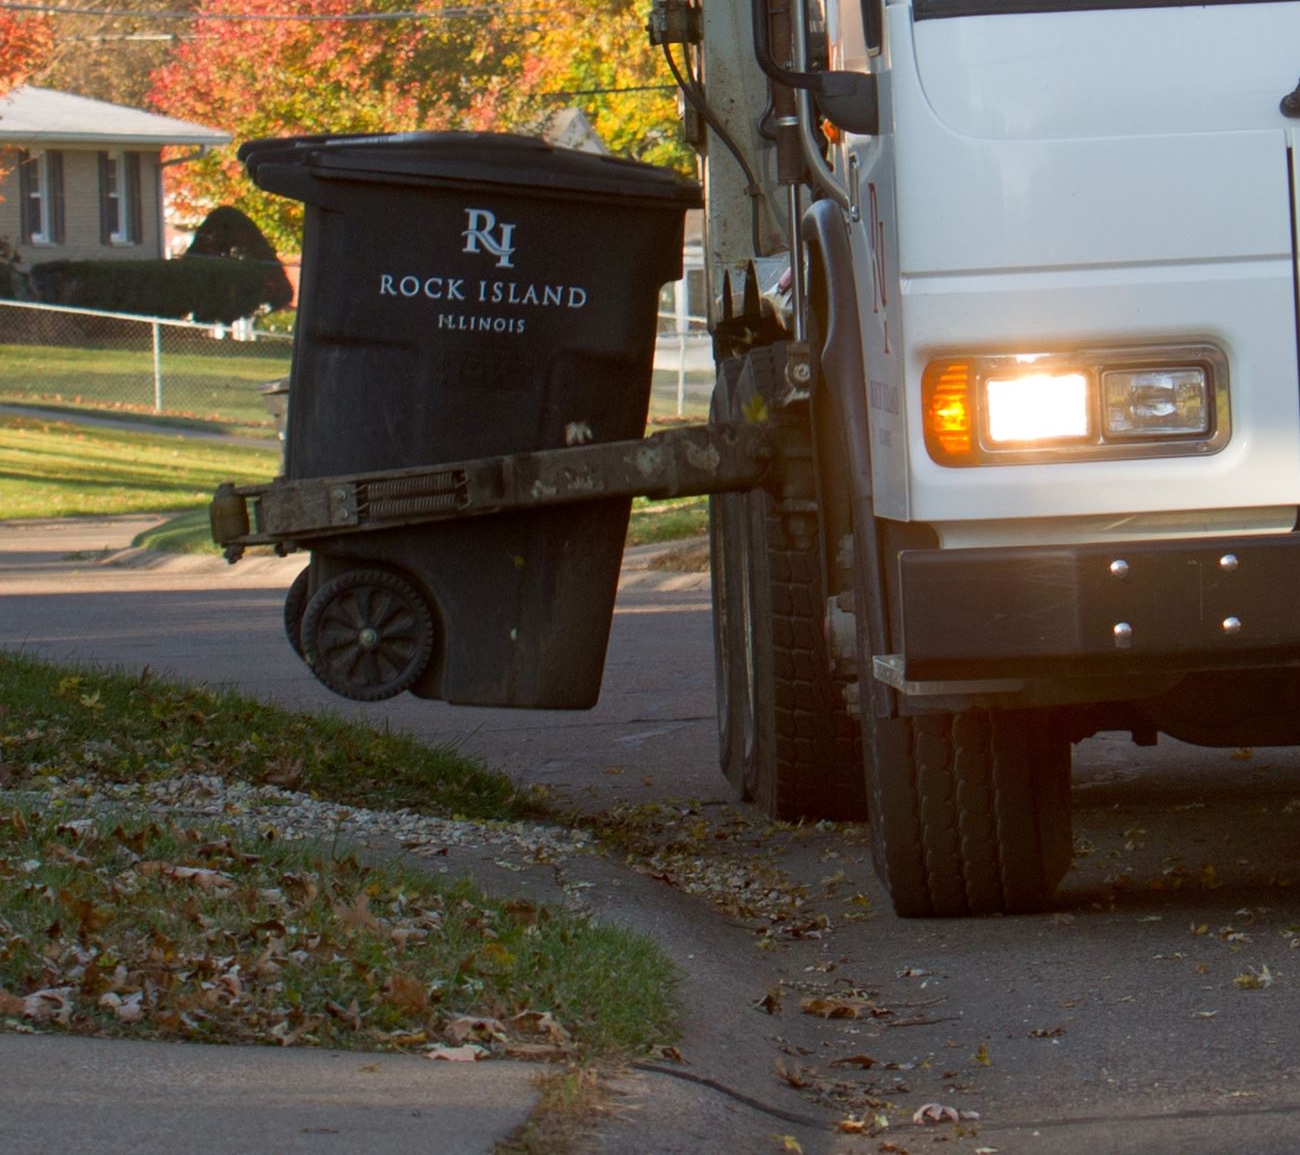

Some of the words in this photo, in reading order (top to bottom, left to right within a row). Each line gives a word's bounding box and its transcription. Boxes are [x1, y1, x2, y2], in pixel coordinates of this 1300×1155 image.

[461, 207, 517, 269] RI
[379, 273, 466, 302] ROCK
[478, 280, 588, 309] ISLAND
[437, 313, 527, 334] ILLINOIS
